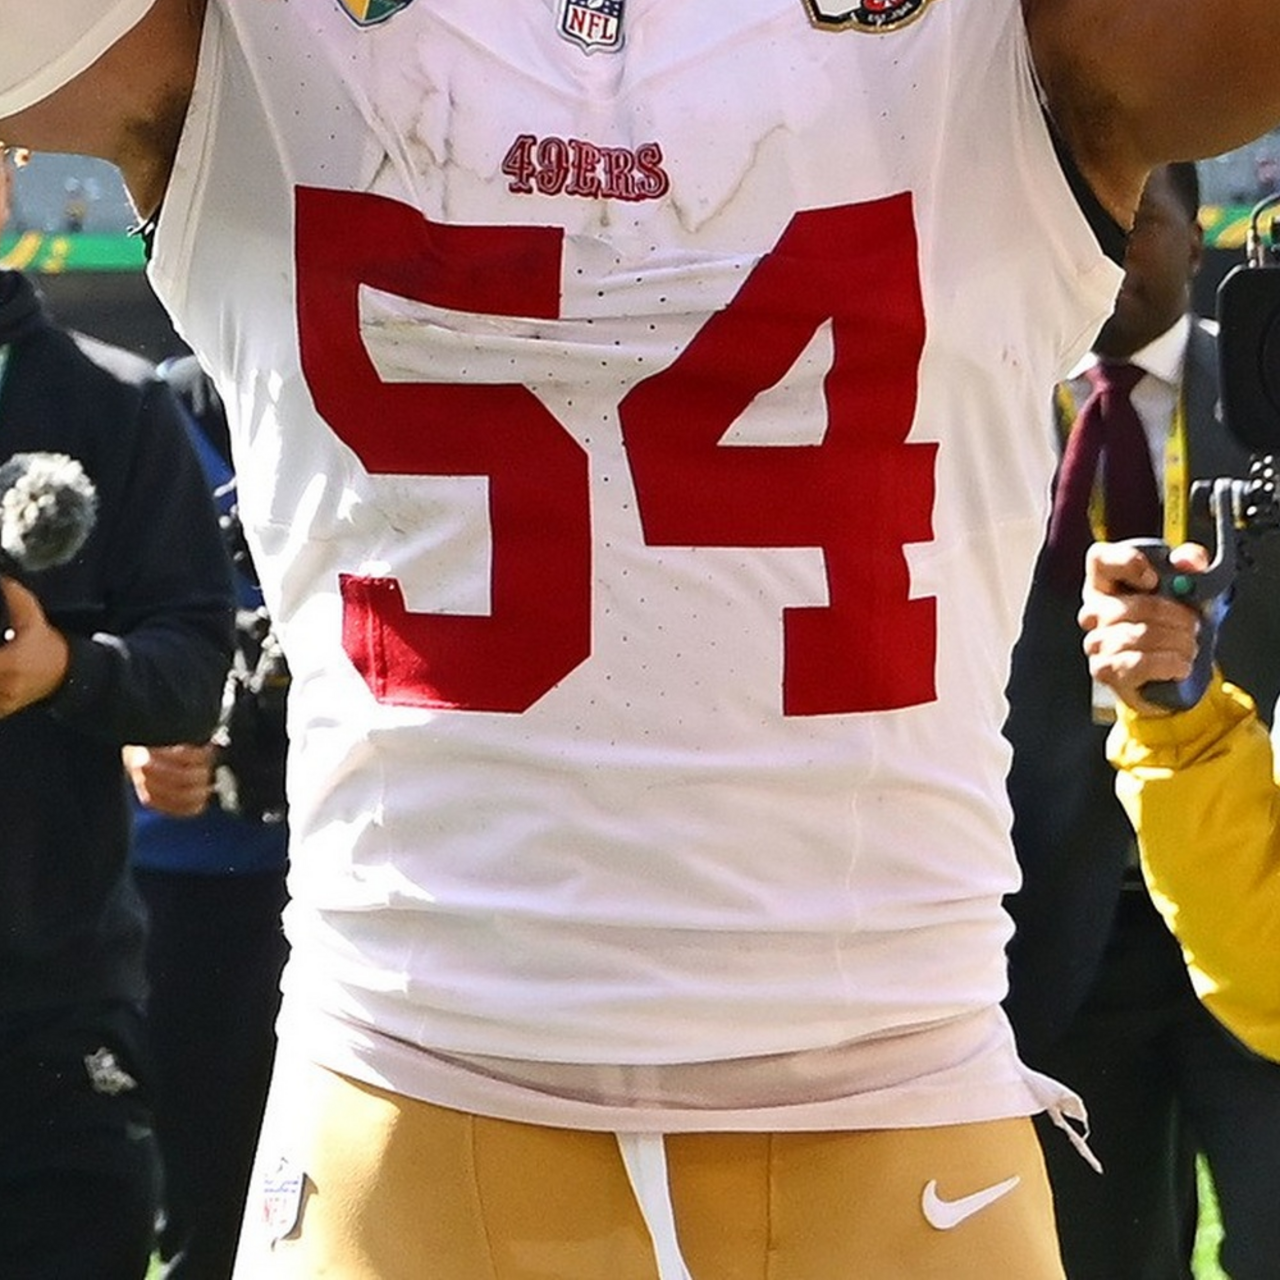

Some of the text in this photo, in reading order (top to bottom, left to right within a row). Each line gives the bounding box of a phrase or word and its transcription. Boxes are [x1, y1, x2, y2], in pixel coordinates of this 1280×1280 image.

[569, 8, 615, 40] NFL
[502, 134, 670, 202] 49ERS
[294, 184, 940, 717] 54
